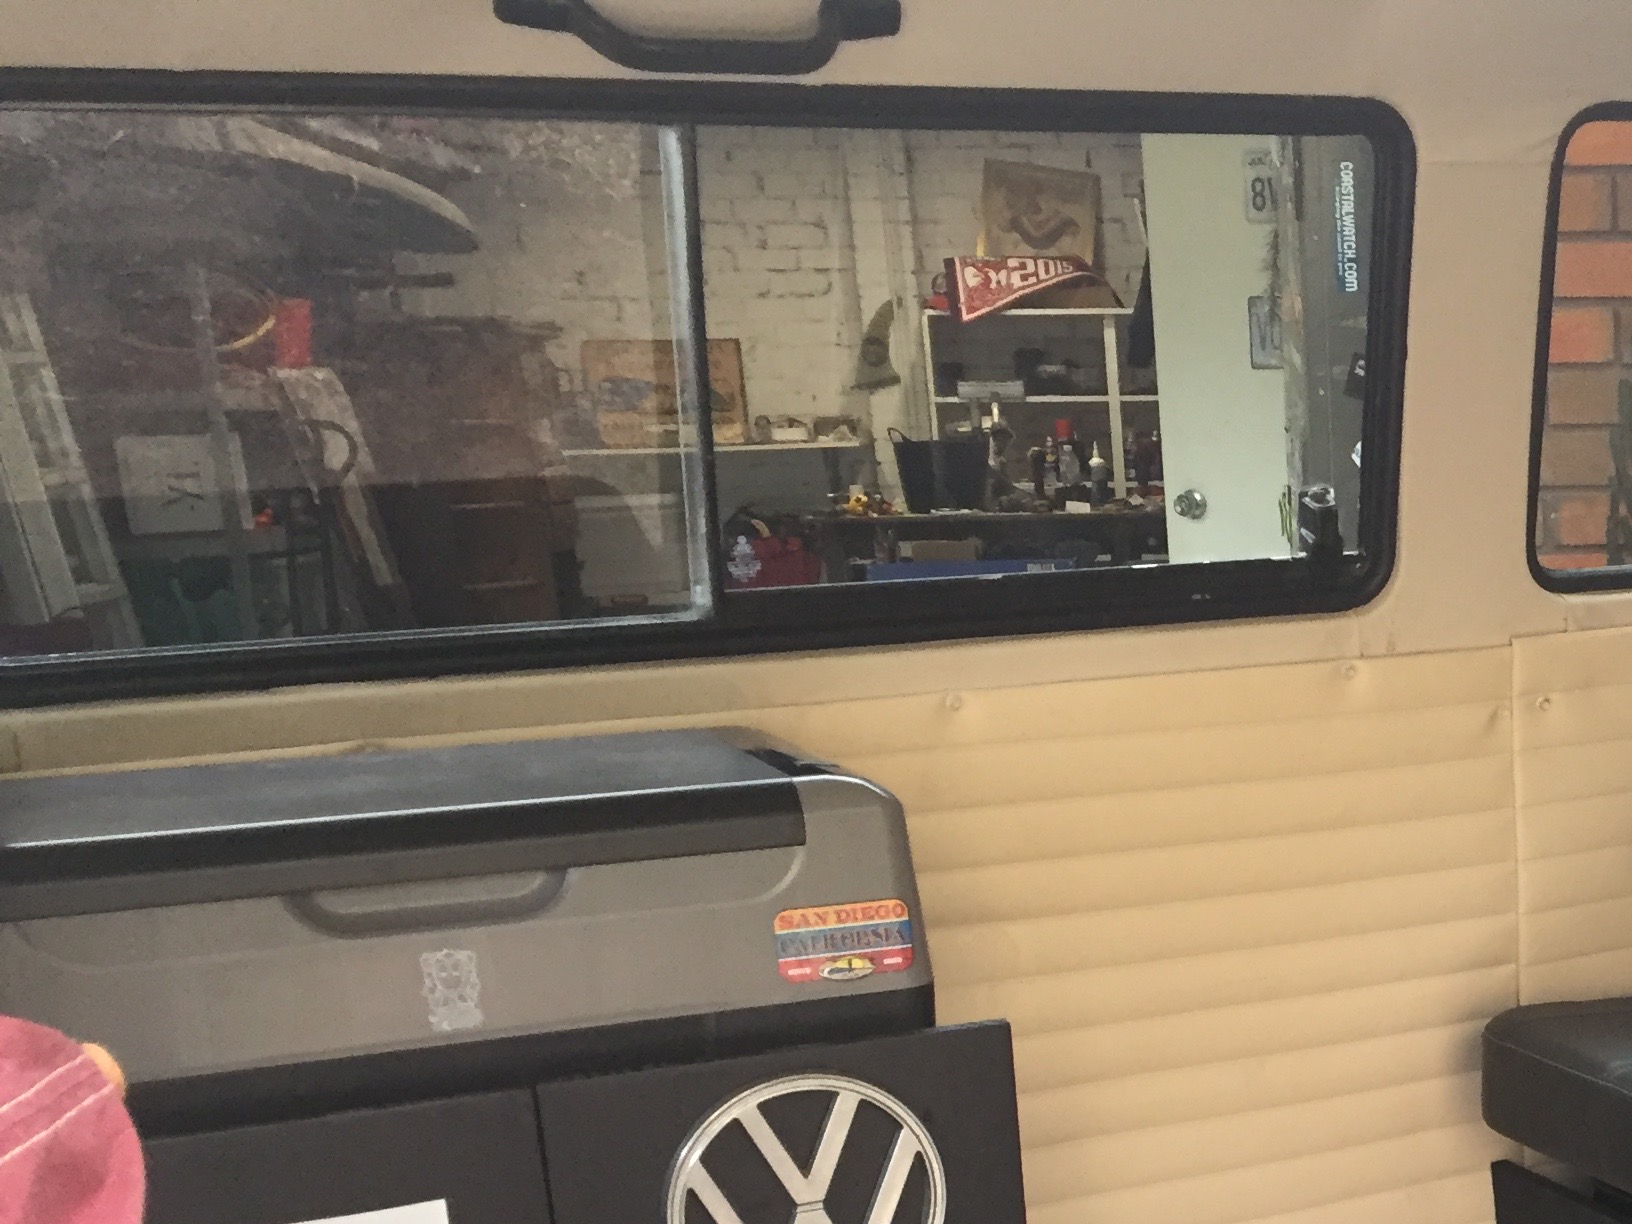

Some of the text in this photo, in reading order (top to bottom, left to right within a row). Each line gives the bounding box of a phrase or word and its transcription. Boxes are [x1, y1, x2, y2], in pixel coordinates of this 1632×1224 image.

[1340, 161, 1358, 292] COASTALWATCH.COM
[779, 902, 906, 928] SAN DIEGO
